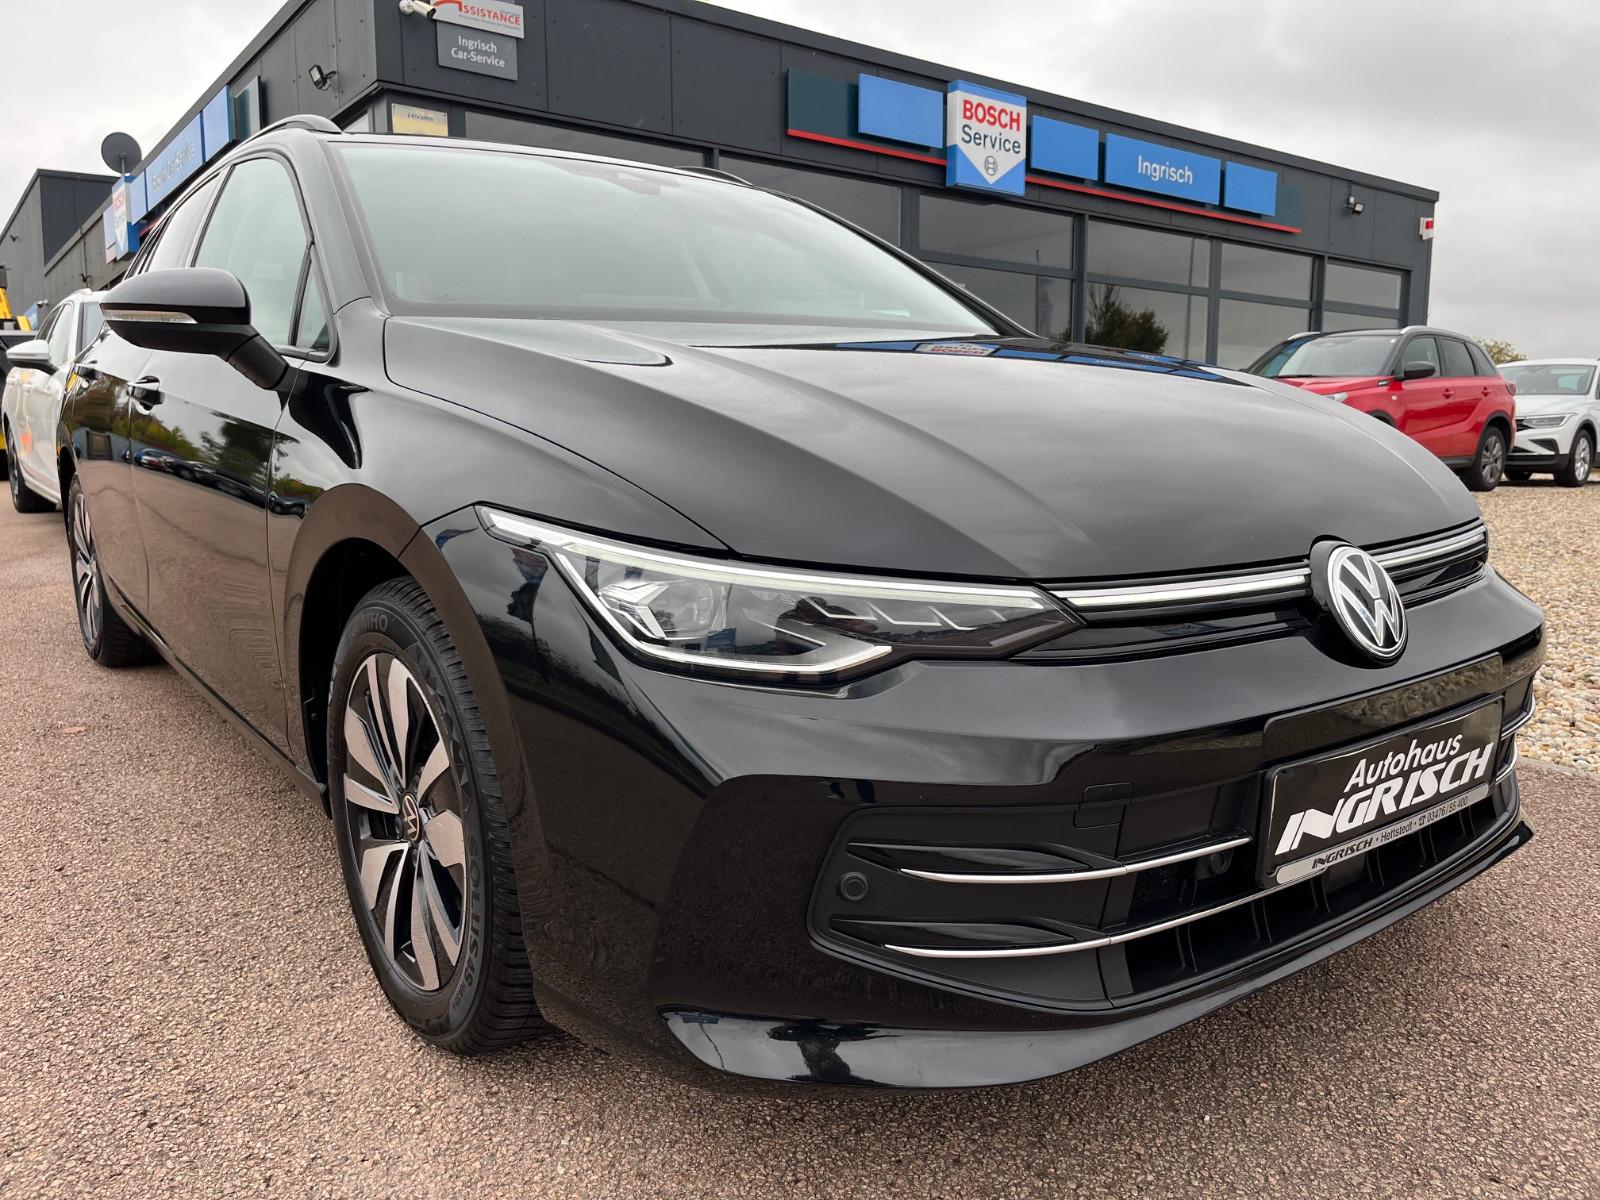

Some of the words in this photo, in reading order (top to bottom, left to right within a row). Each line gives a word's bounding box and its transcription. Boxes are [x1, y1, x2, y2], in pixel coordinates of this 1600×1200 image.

[451, 48, 505, 67] Car-Service
[458, 36, 497, 53] Ingrisch
[963, 99, 1021, 132] BOSCH
[961, 124, 1021, 154] Service
[1138, 154, 1193, 185] Ingrisch
[1343, 734, 1463, 793] Autohaus
[1275, 742, 1494, 856] INGRISCH
[1311, 836, 1373, 870] INGRISCH
